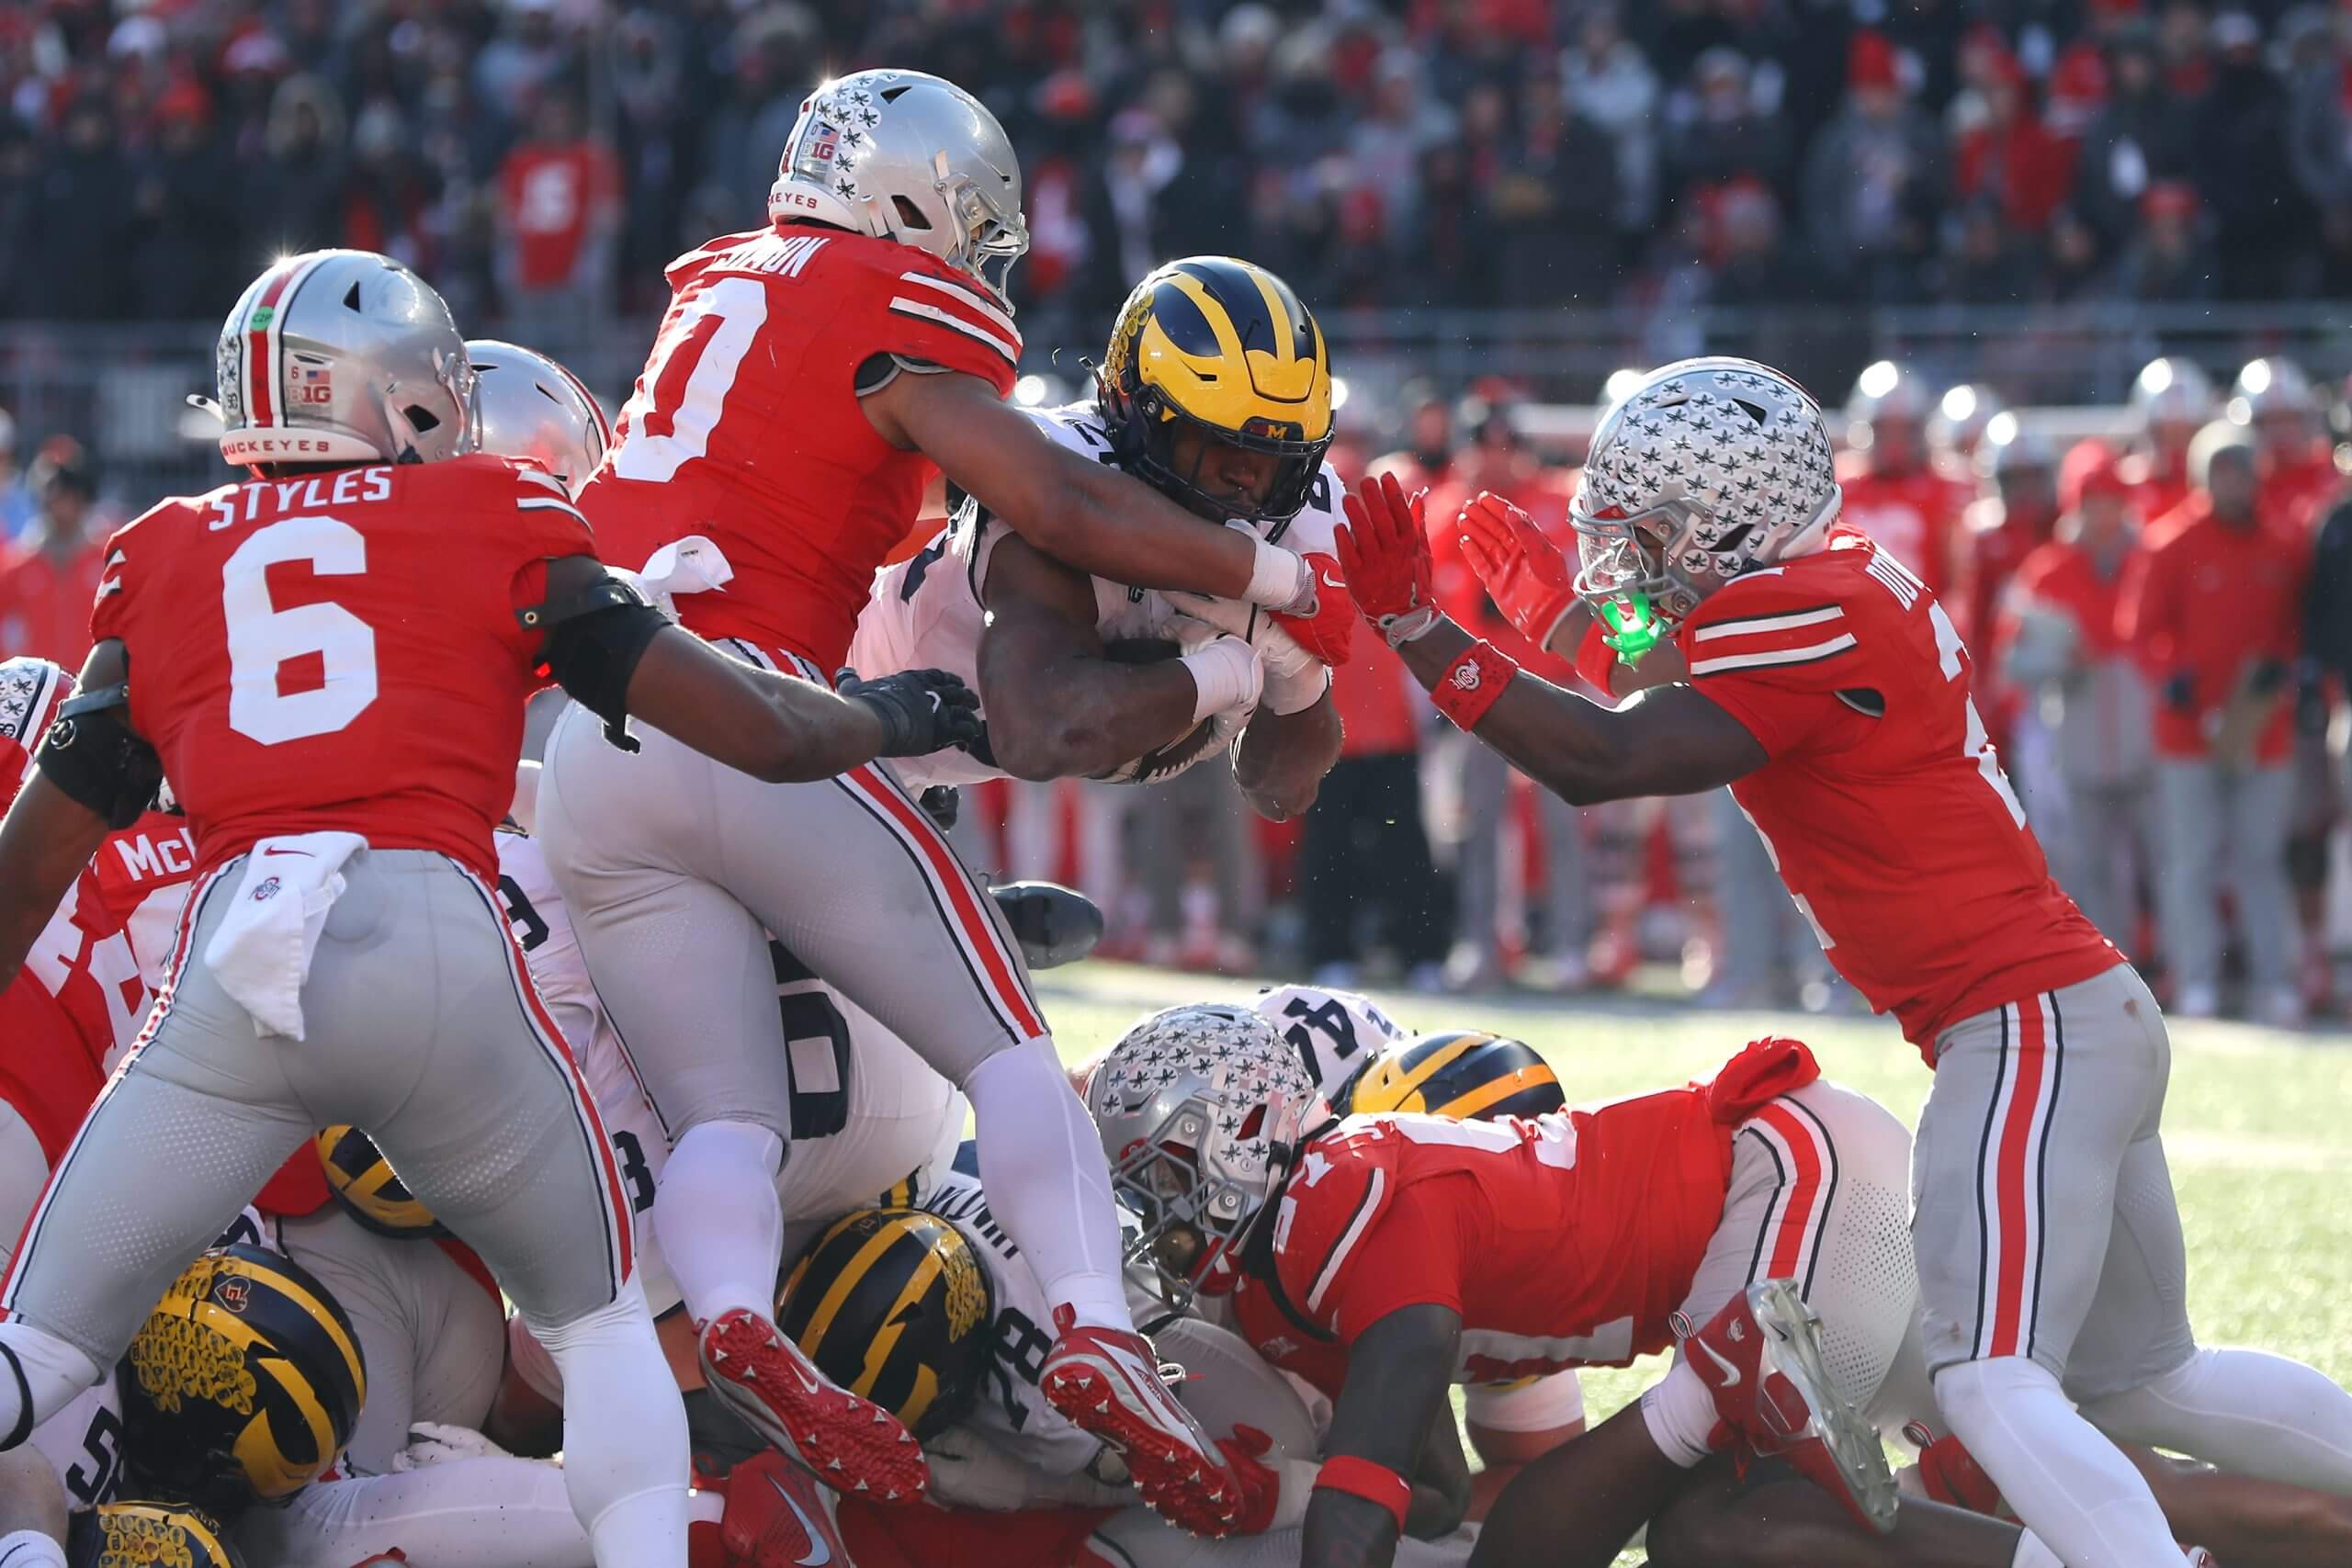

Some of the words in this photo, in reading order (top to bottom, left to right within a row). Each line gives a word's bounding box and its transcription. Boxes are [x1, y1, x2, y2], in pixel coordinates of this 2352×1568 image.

[289, 367, 300, 379] 6
[616, 276, 768, 483] 0
[1266, 424, 1288, 440] M
[208, 466, 394, 532] STYLES
[222, 515, 379, 746] 6
